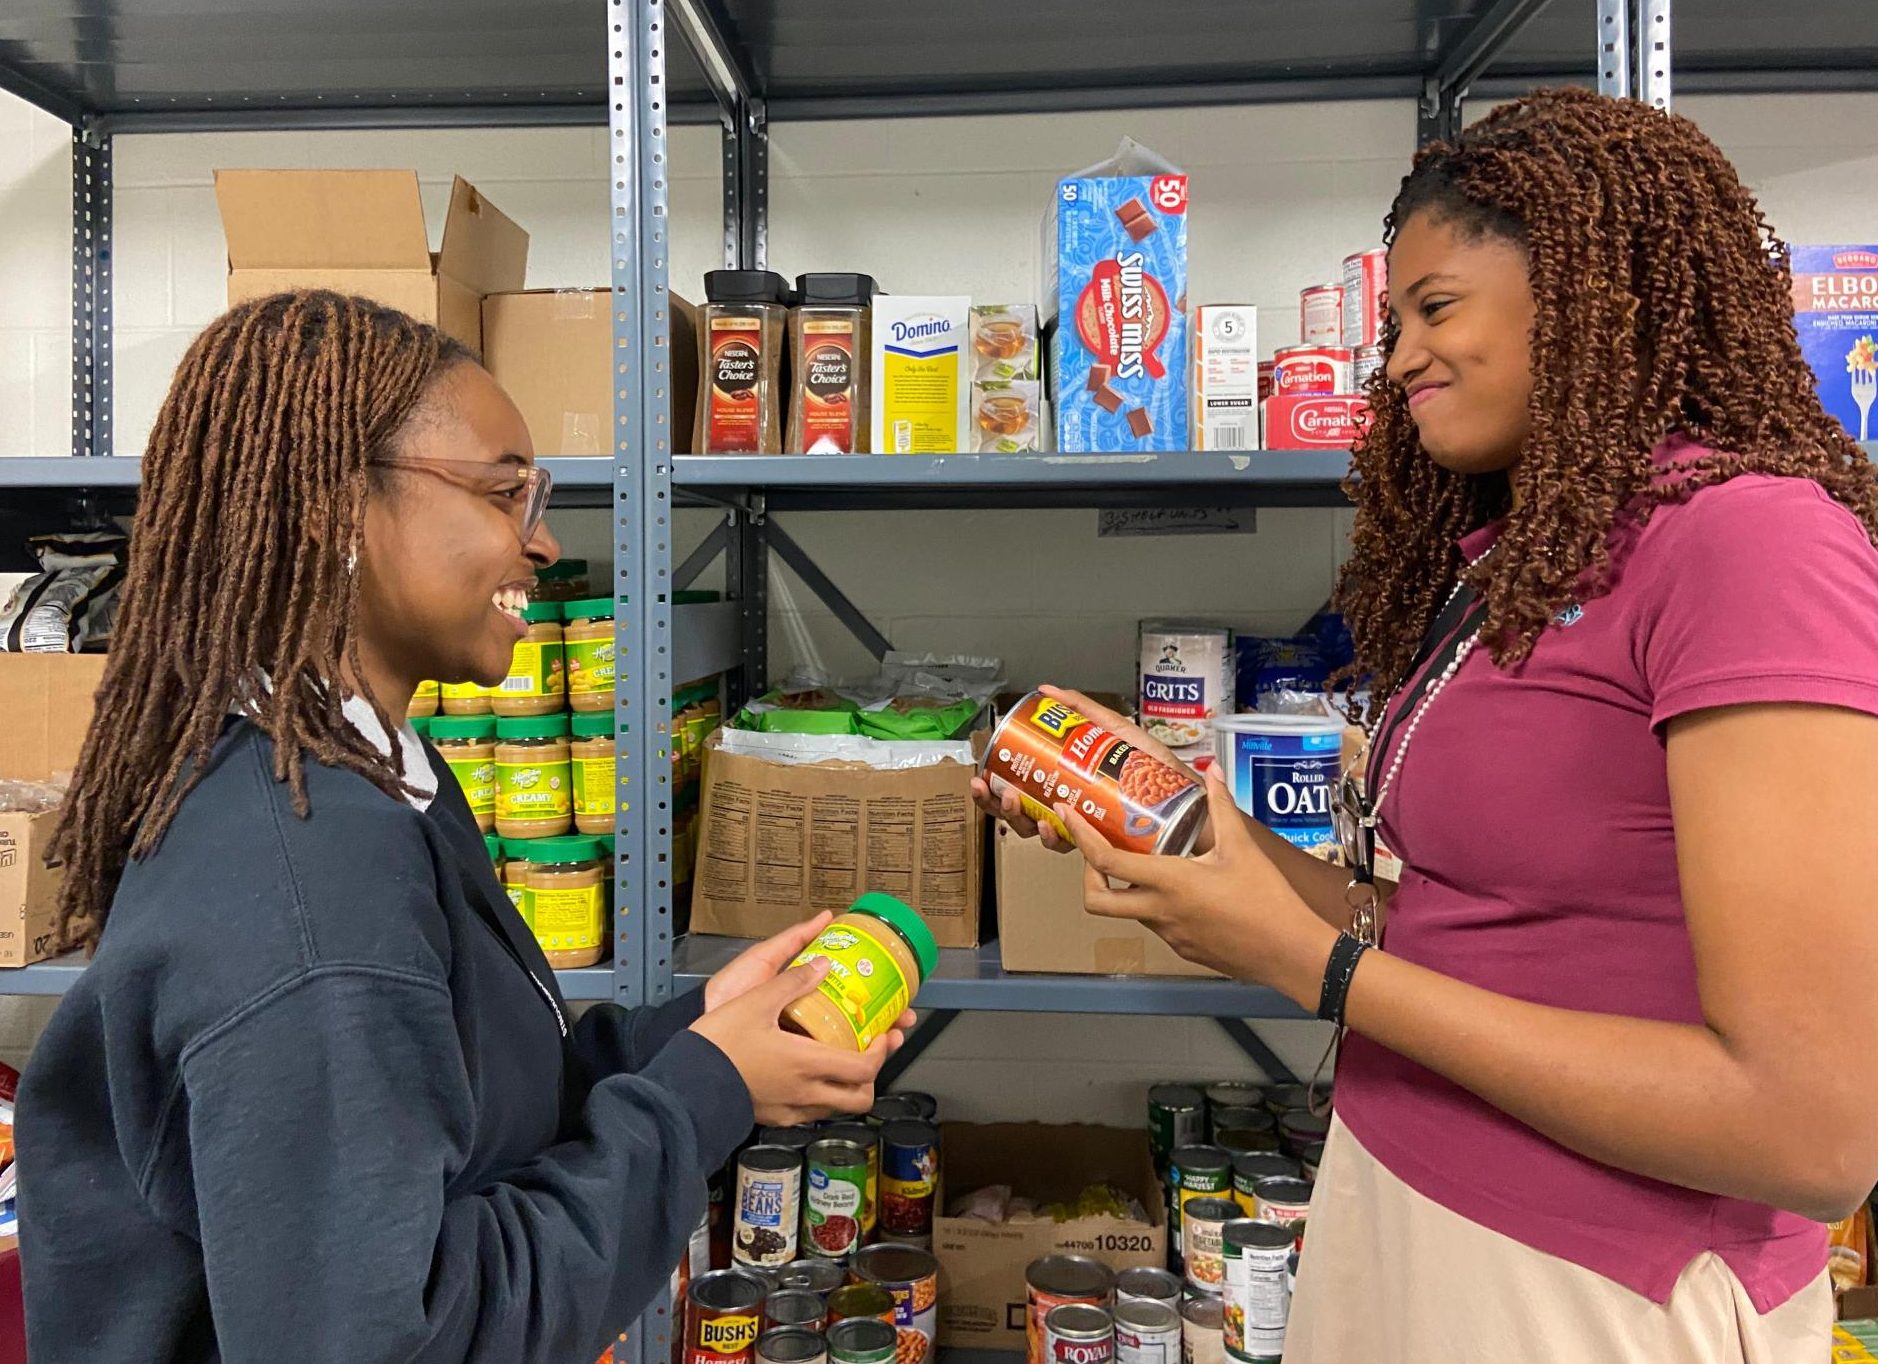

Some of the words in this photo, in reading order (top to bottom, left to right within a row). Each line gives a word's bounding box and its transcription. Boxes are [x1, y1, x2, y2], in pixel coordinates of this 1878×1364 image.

[1063, 185, 1077, 201] 50
[1159, 180, 1181, 208] 50
[1100, 278, 1113, 302] Milk
[891, 317, 951, 342] Domino
[1103, 302, 1121, 356] Chocolate
[1225, 321, 1233, 334] 5
[717, 358, 755, 370] Taster's
[809, 361, 848, 373] Taster's
[718, 370, 754, 381] Choice
[810, 373, 847, 384] Choice
[1281, 370, 1332, 388] Carnation
[1299, 409, 1369, 432] Carnati
[1155, 664, 1186, 673] QUAKER
[1146, 681, 1200, 702] GRITS
[1037, 703, 1075, 732] BUS
[1292, 772, 1325, 783] ROLLED
[511, 793, 552, 804] CREAMY
[1267, 782, 1329, 814] OAT
[1183, 1181, 1215, 1191] HARVEST
[1184, 1174, 1210, 1182] HAPPY
[901, 1186, 930, 1195] Kidney
[741, 1197, 783, 1215] BEANS
[1094, 1235, 1152, 1252] 10320
[704, 1320, 756, 1342] BUSH'S
[1064, 1344, 1107, 1364] ROYAL
